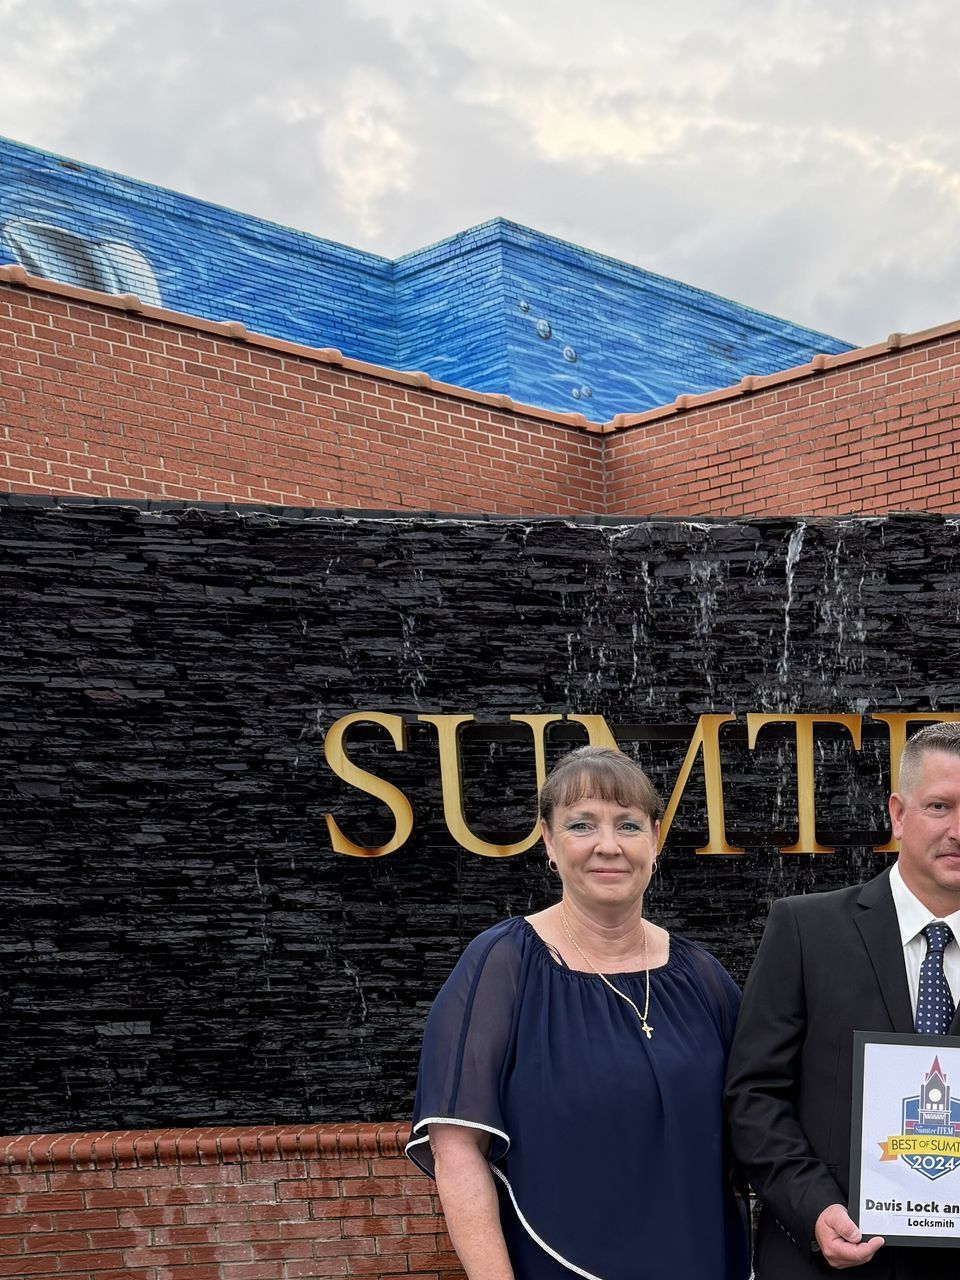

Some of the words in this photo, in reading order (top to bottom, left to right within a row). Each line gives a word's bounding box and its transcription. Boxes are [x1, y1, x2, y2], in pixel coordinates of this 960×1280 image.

[891, 1139, 918, 1150] BEST
[912, 1155, 956, 1170] 2024
[865, 1199, 902, 1211] Davis
[906, 1200, 940, 1213] Lock
[907, 1218, 955, 1228] Locksmith
